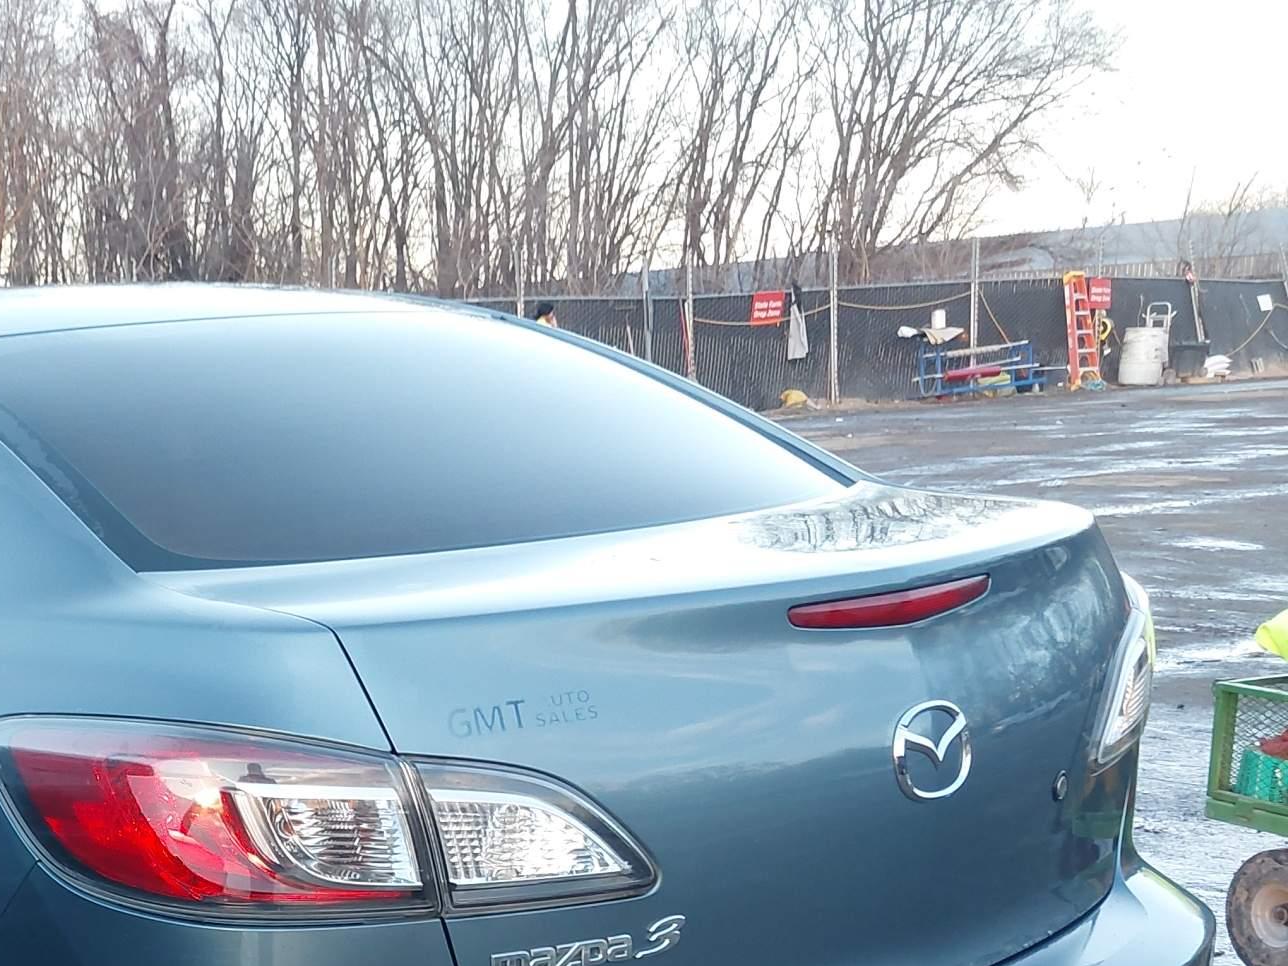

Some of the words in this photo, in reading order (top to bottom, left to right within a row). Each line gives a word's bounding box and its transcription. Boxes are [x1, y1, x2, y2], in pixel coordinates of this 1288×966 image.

[448, 699, 526, 739] GMT
[549, 689, 591, 707] UTO
[535, 704, 599, 728] SALES
[635, 914, 686, 959] 3
